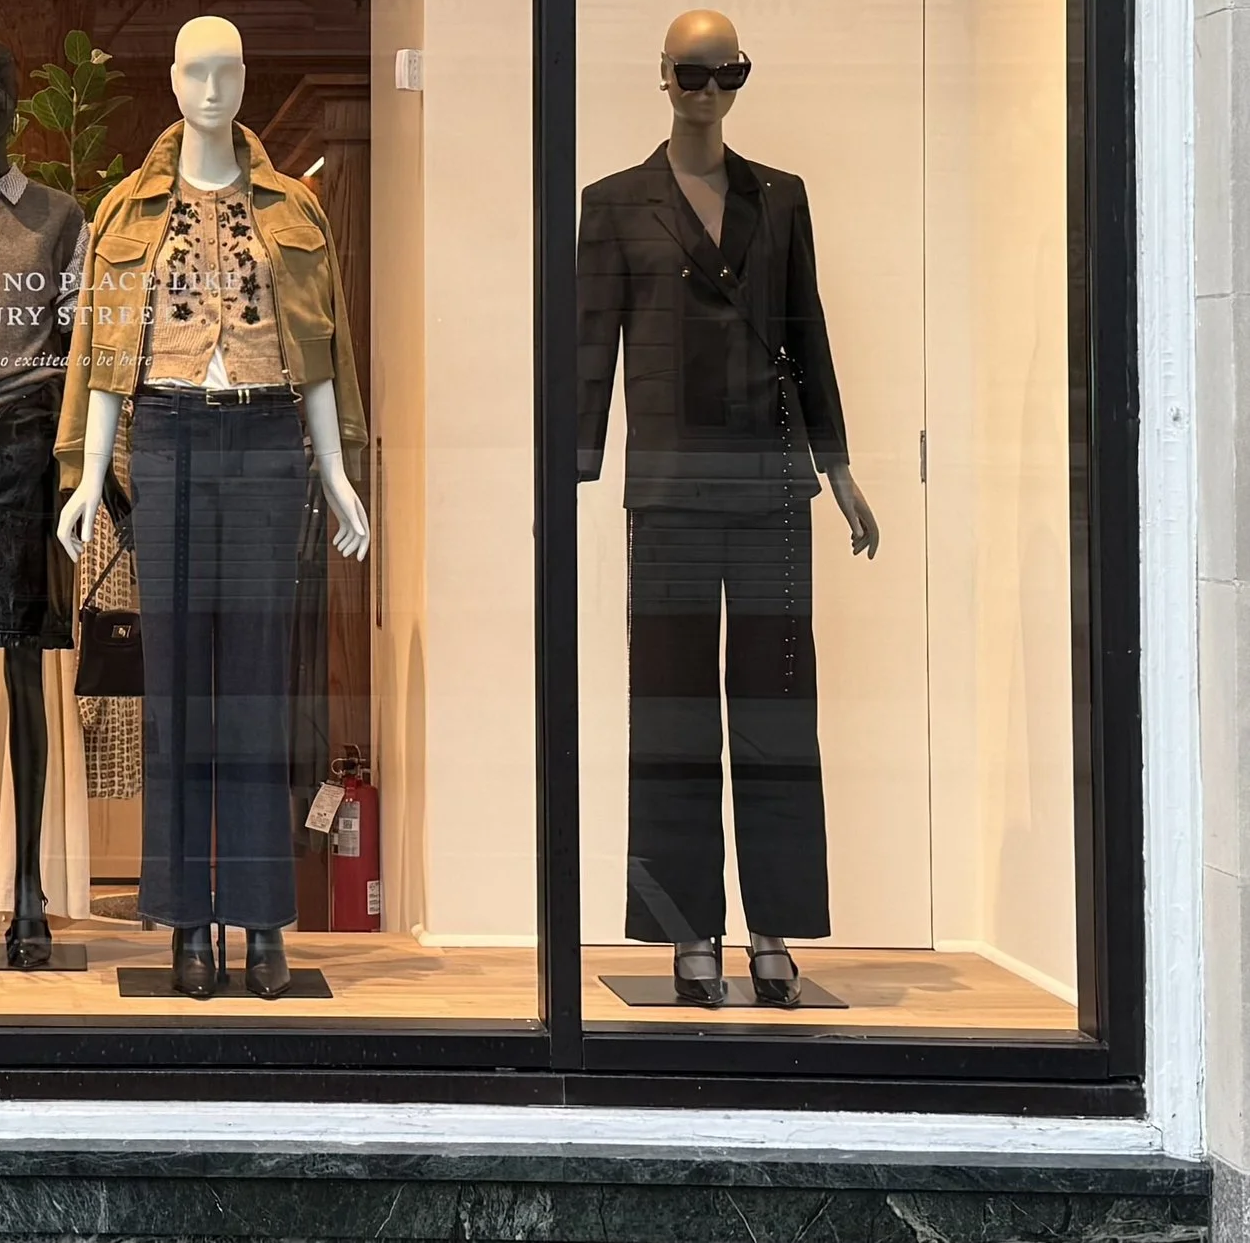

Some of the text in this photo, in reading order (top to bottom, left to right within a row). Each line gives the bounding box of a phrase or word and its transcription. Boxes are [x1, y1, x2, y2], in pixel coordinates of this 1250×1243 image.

[2, 271, 46, 292] NO
[59, 271, 157, 291] PLACE
[170, 271, 242, 291] LIKE
[14, 351, 70, 367] excited
[76, 353, 91, 367] to
[96, 351, 113, 367] be
